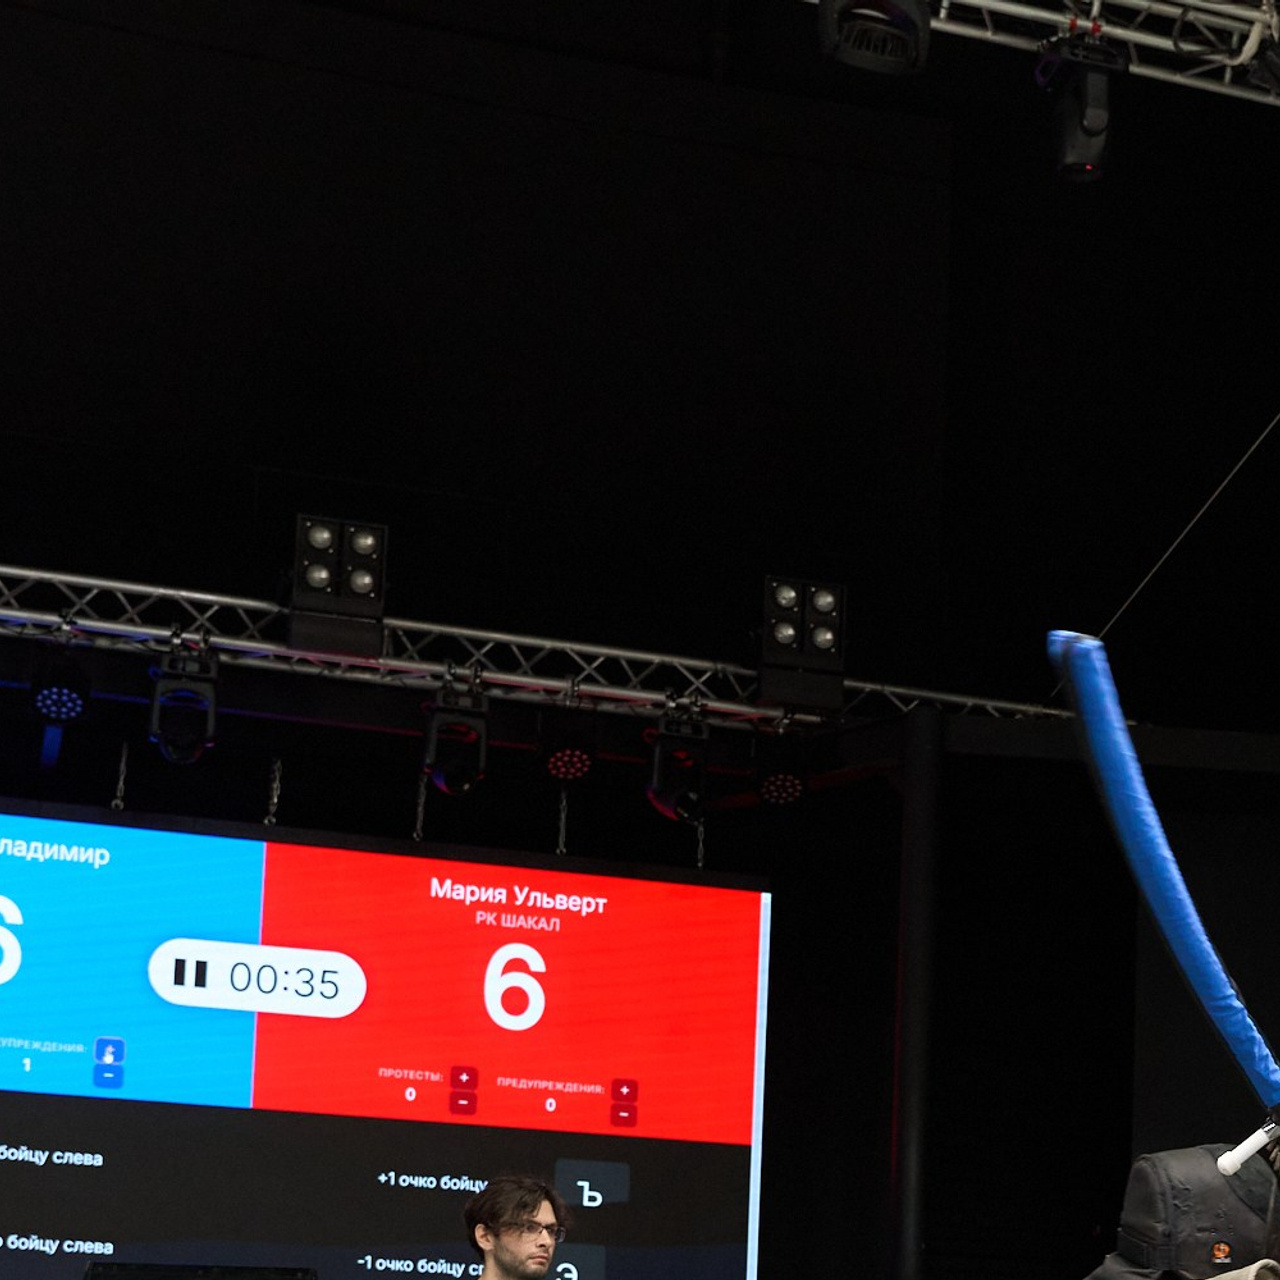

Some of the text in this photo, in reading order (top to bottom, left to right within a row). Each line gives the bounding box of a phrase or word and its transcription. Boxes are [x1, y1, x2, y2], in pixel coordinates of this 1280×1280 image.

[430, 877, 608, 917] Мария Ульверт
[476, 911, 561, 933] РК ШАКАЛ
[230, 962, 340, 1000] 00:35
[483, 942, 548, 1031] 6
[22, 1057, 31, 1072] 1
[378, 1067, 444, 1082] ПРОТЕСТЫ:
[404, 1086, 417, 1102] 0
[496, 1076, 605, 1095] ПРЕДУПРЕЖДЕНИЯ:
[545, 1097, 557, 1113] 0
[52, 1150, 104, 1166] слева
[377, 1171, 396, 1186] +1
[398, 1174, 437, 1189] очко
[576, 1180, 603, 1207] Ъ
[6, 1234, 60, 1255] бойцу
[62, 1240, 114, 1255] слева
[357, 1255, 373, 1270] -1
[375, 1259, 414, 1273] очко
[416, 1258, 466, 1278] бойцу
